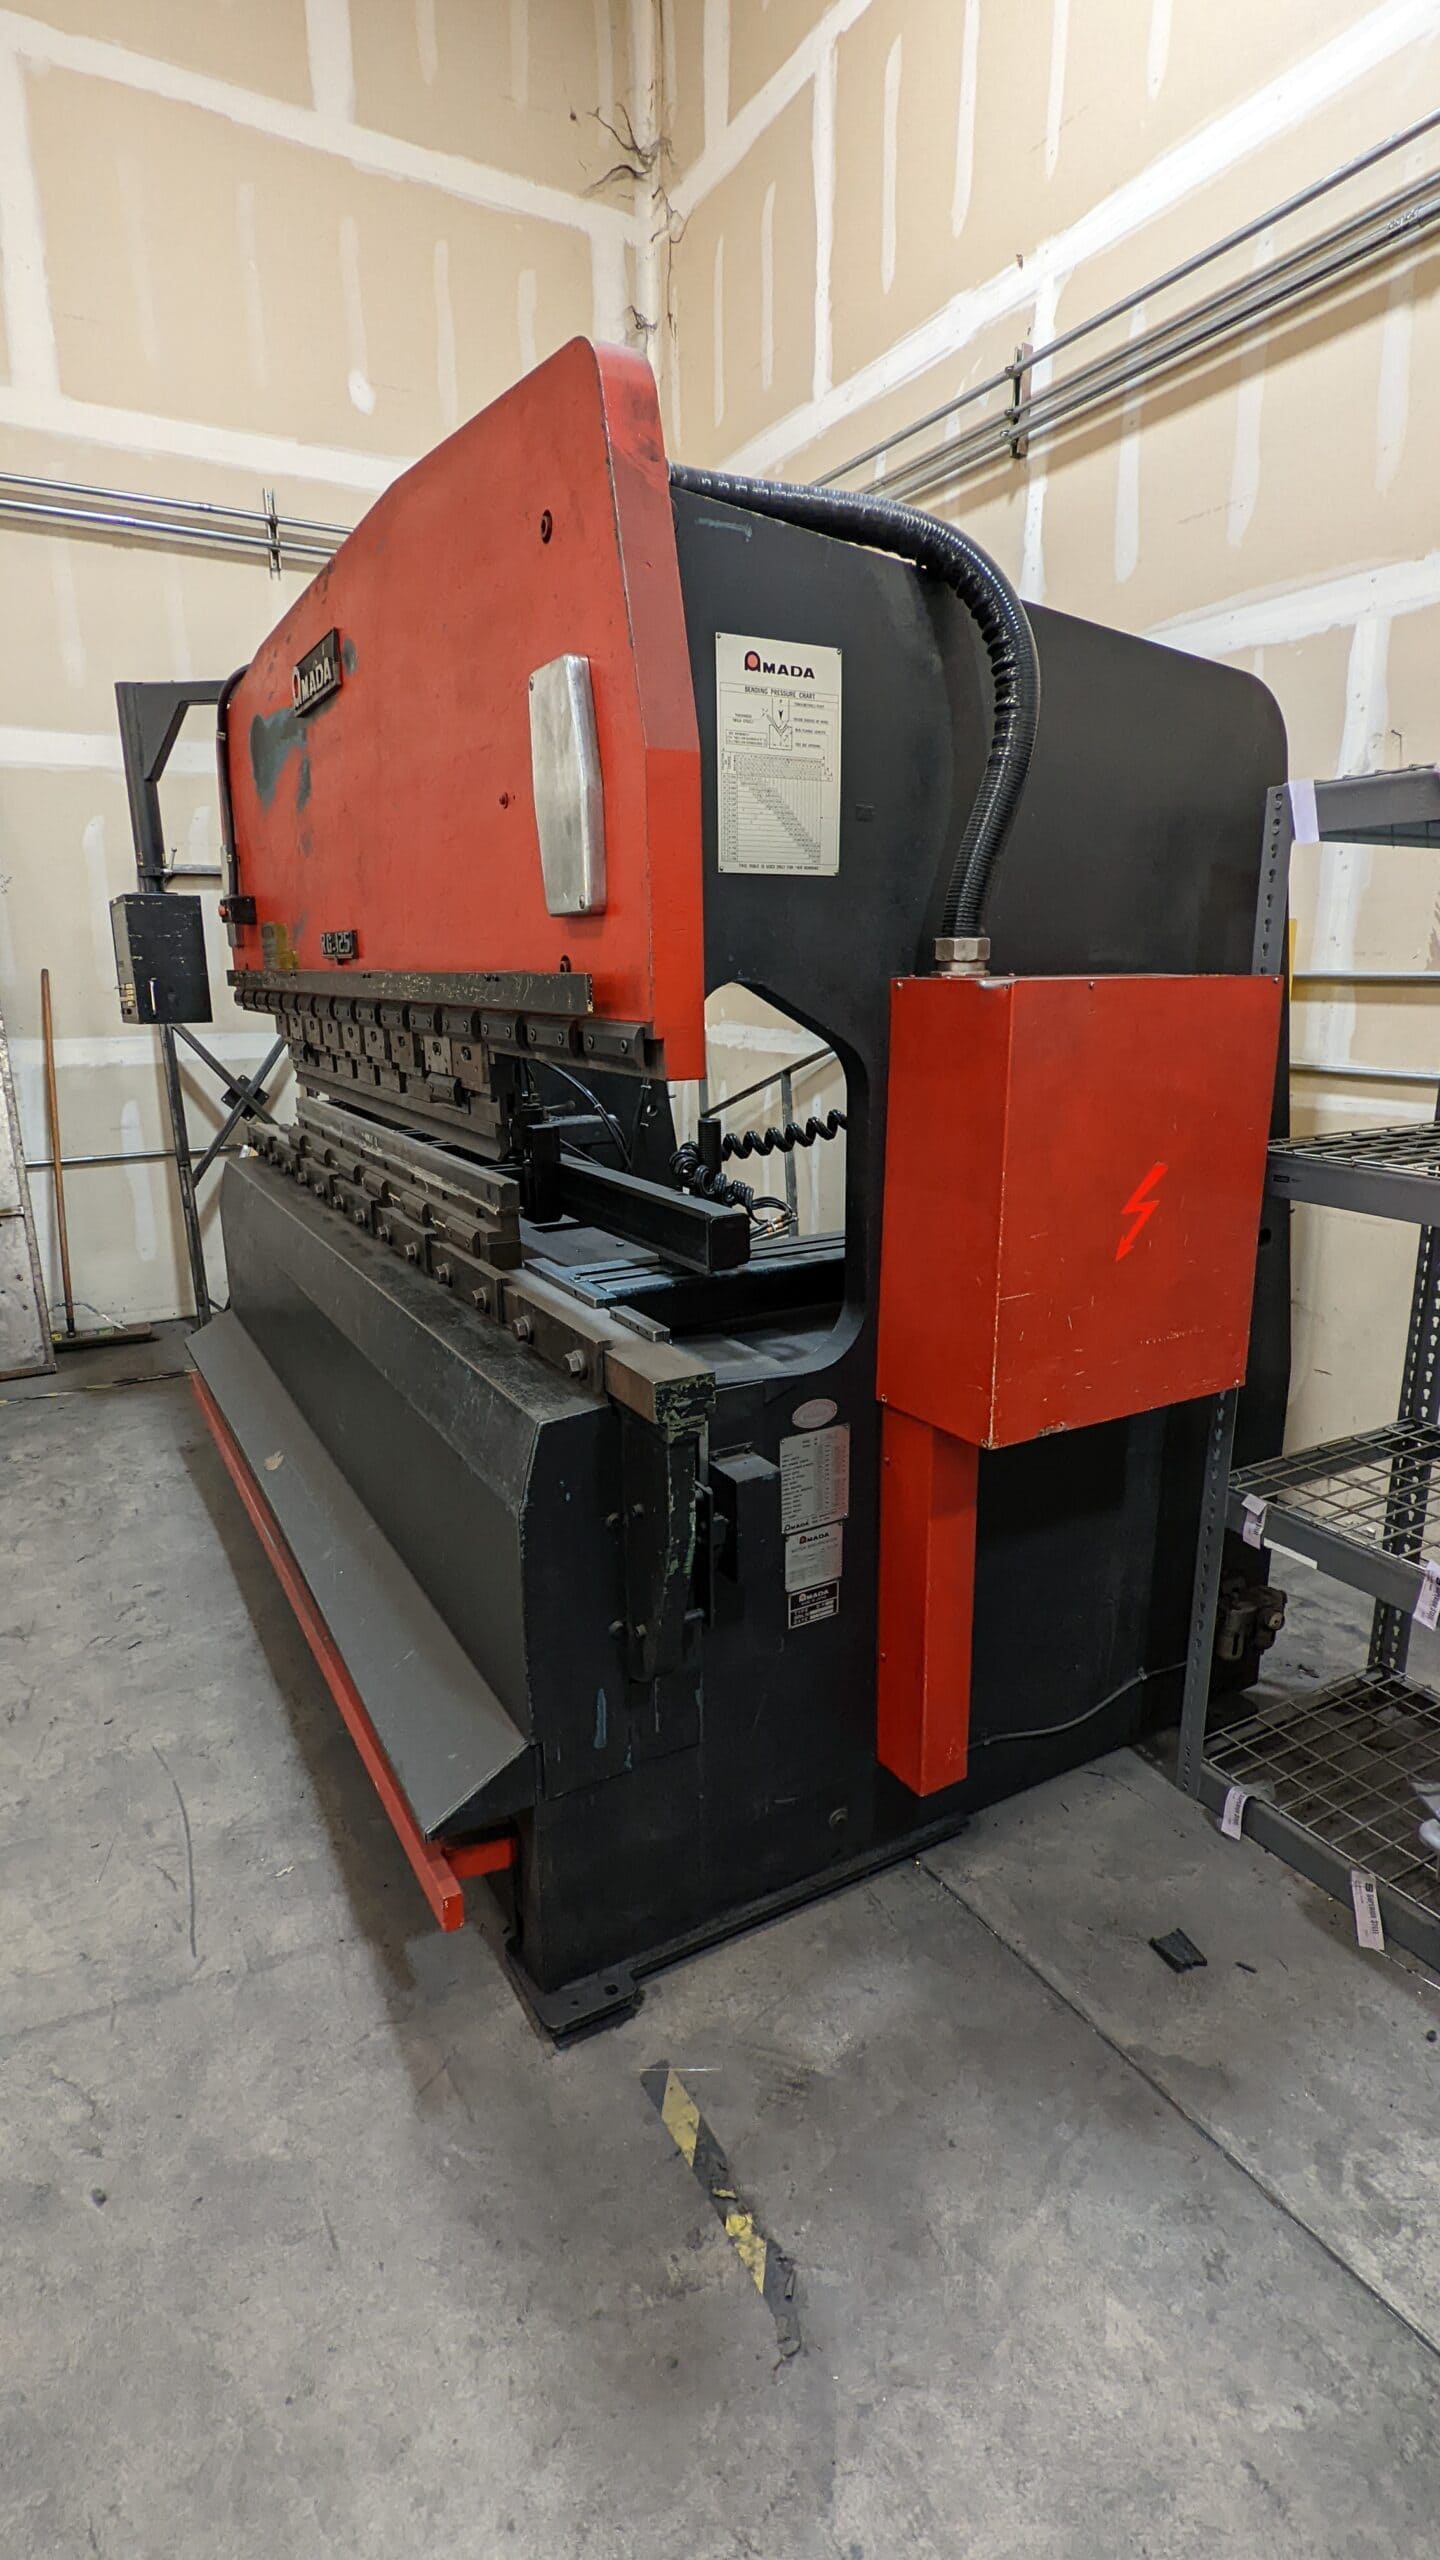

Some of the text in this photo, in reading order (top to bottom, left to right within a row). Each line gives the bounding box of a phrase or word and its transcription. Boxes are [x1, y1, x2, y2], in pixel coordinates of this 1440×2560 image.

[744, 650, 815, 679] AMADA
[292, 656, 332, 707] AMADA
[744, 685, 816, 700] BENDING PRESSURE CHART
